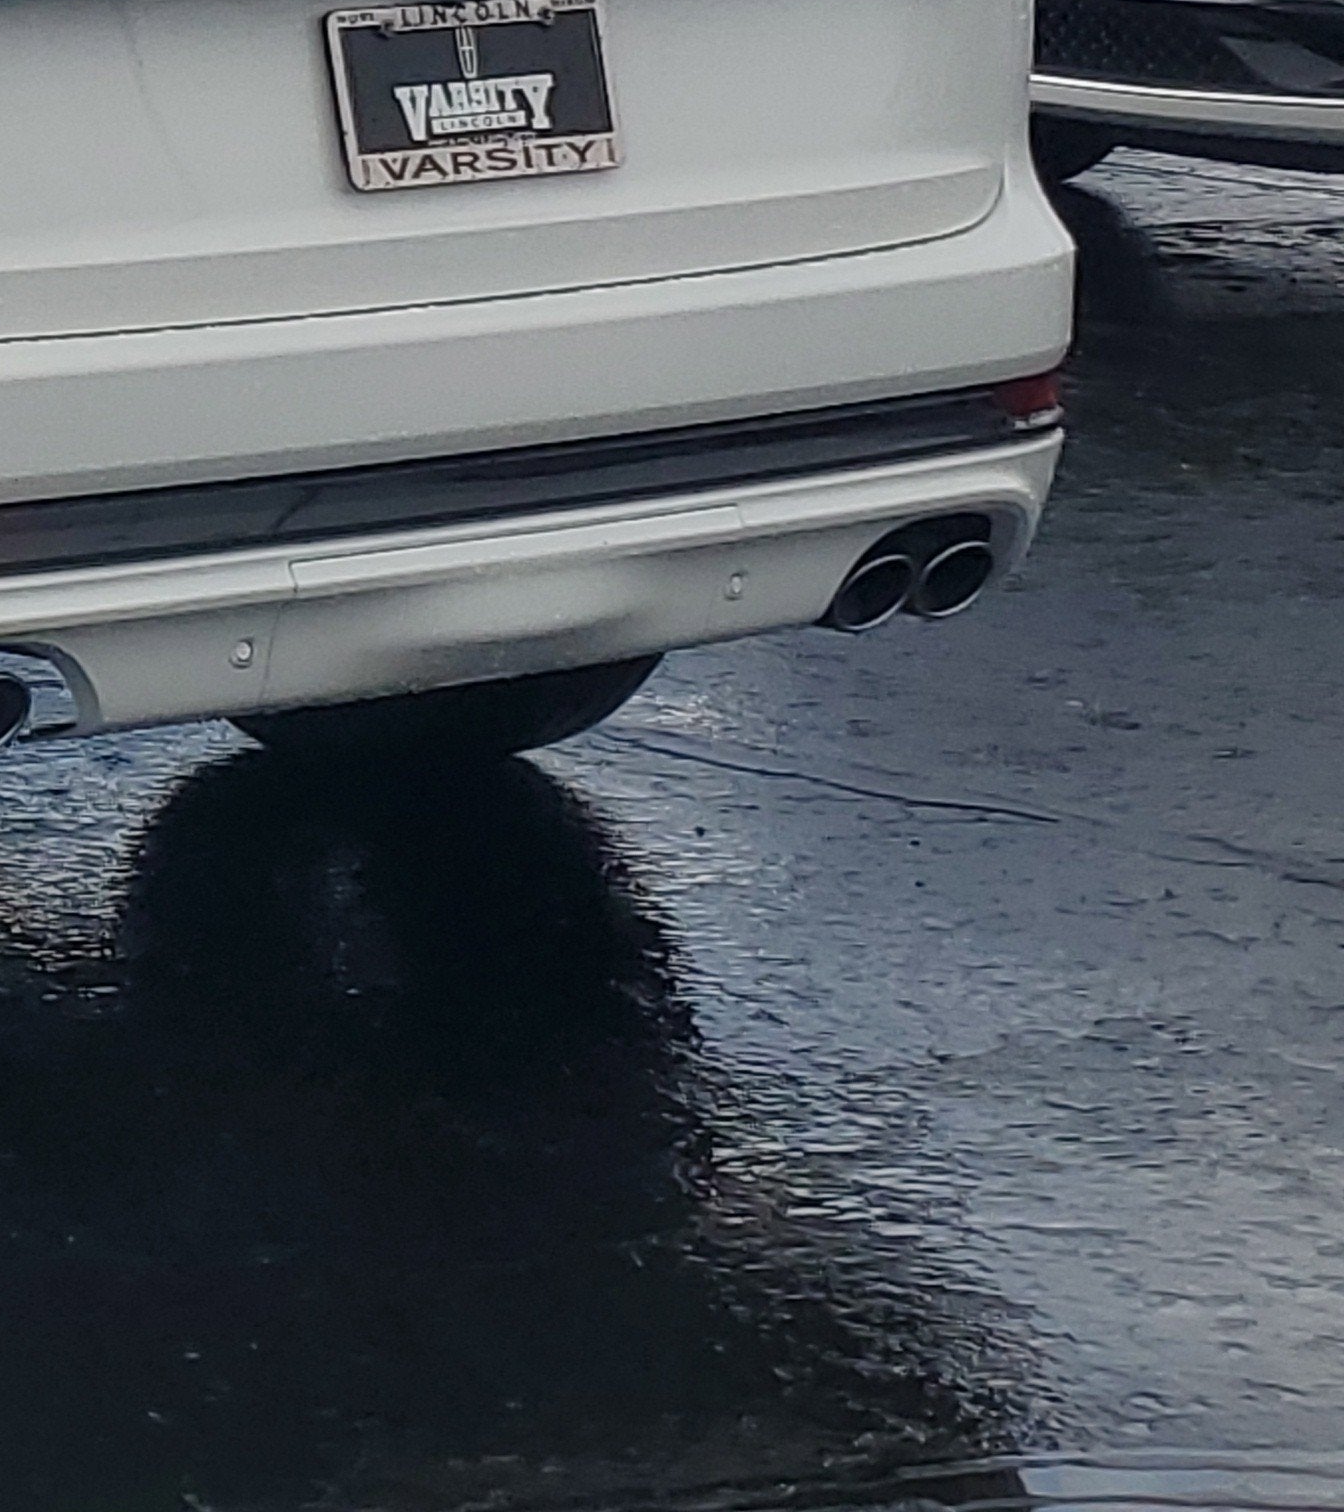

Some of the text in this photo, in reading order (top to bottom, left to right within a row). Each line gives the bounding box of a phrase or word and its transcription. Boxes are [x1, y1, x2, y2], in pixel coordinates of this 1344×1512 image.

[393, 73, 554, 142] VARSITY
[440, 115, 518, 132] LINCOLN
[378, 140, 596, 181] VARSITY
